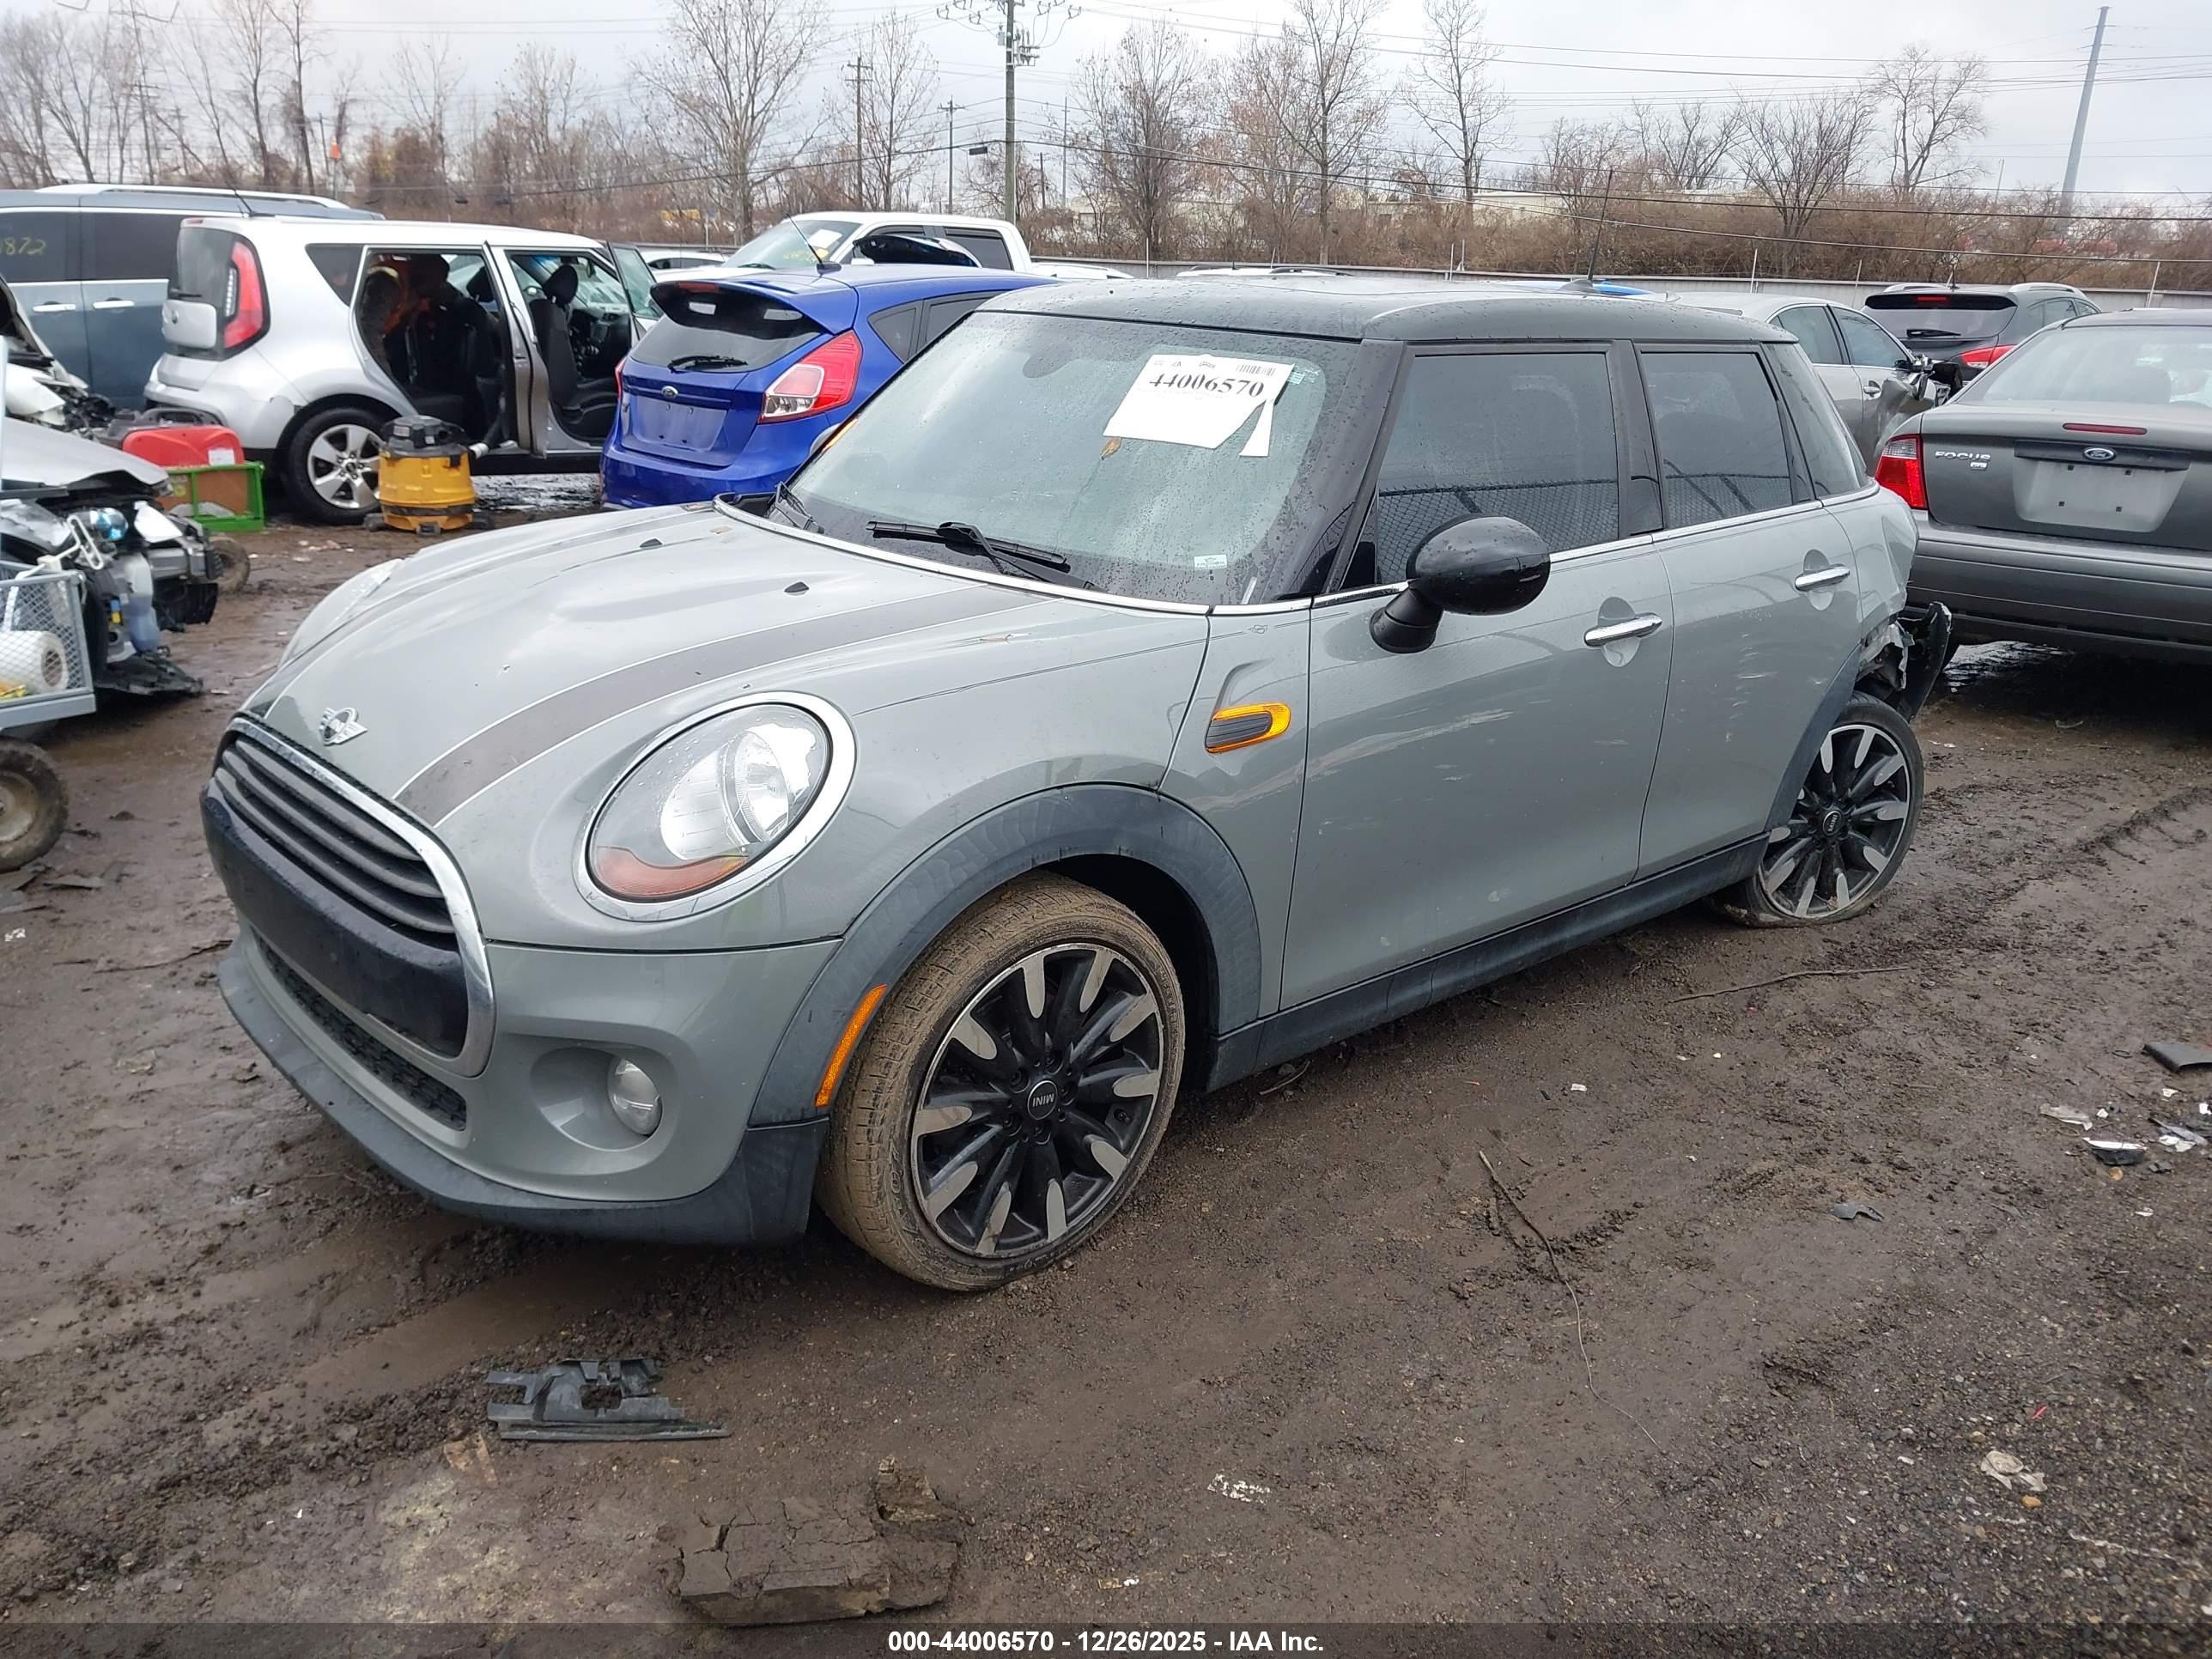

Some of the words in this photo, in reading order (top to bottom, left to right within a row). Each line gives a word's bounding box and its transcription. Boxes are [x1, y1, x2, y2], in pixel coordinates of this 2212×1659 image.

[0, 236, 46, 255] 872
[1149, 373, 1265, 398] 44006570
[1935, 450, 1991, 462] FOCUS
[1032, 1092, 1054, 1108] MINI
